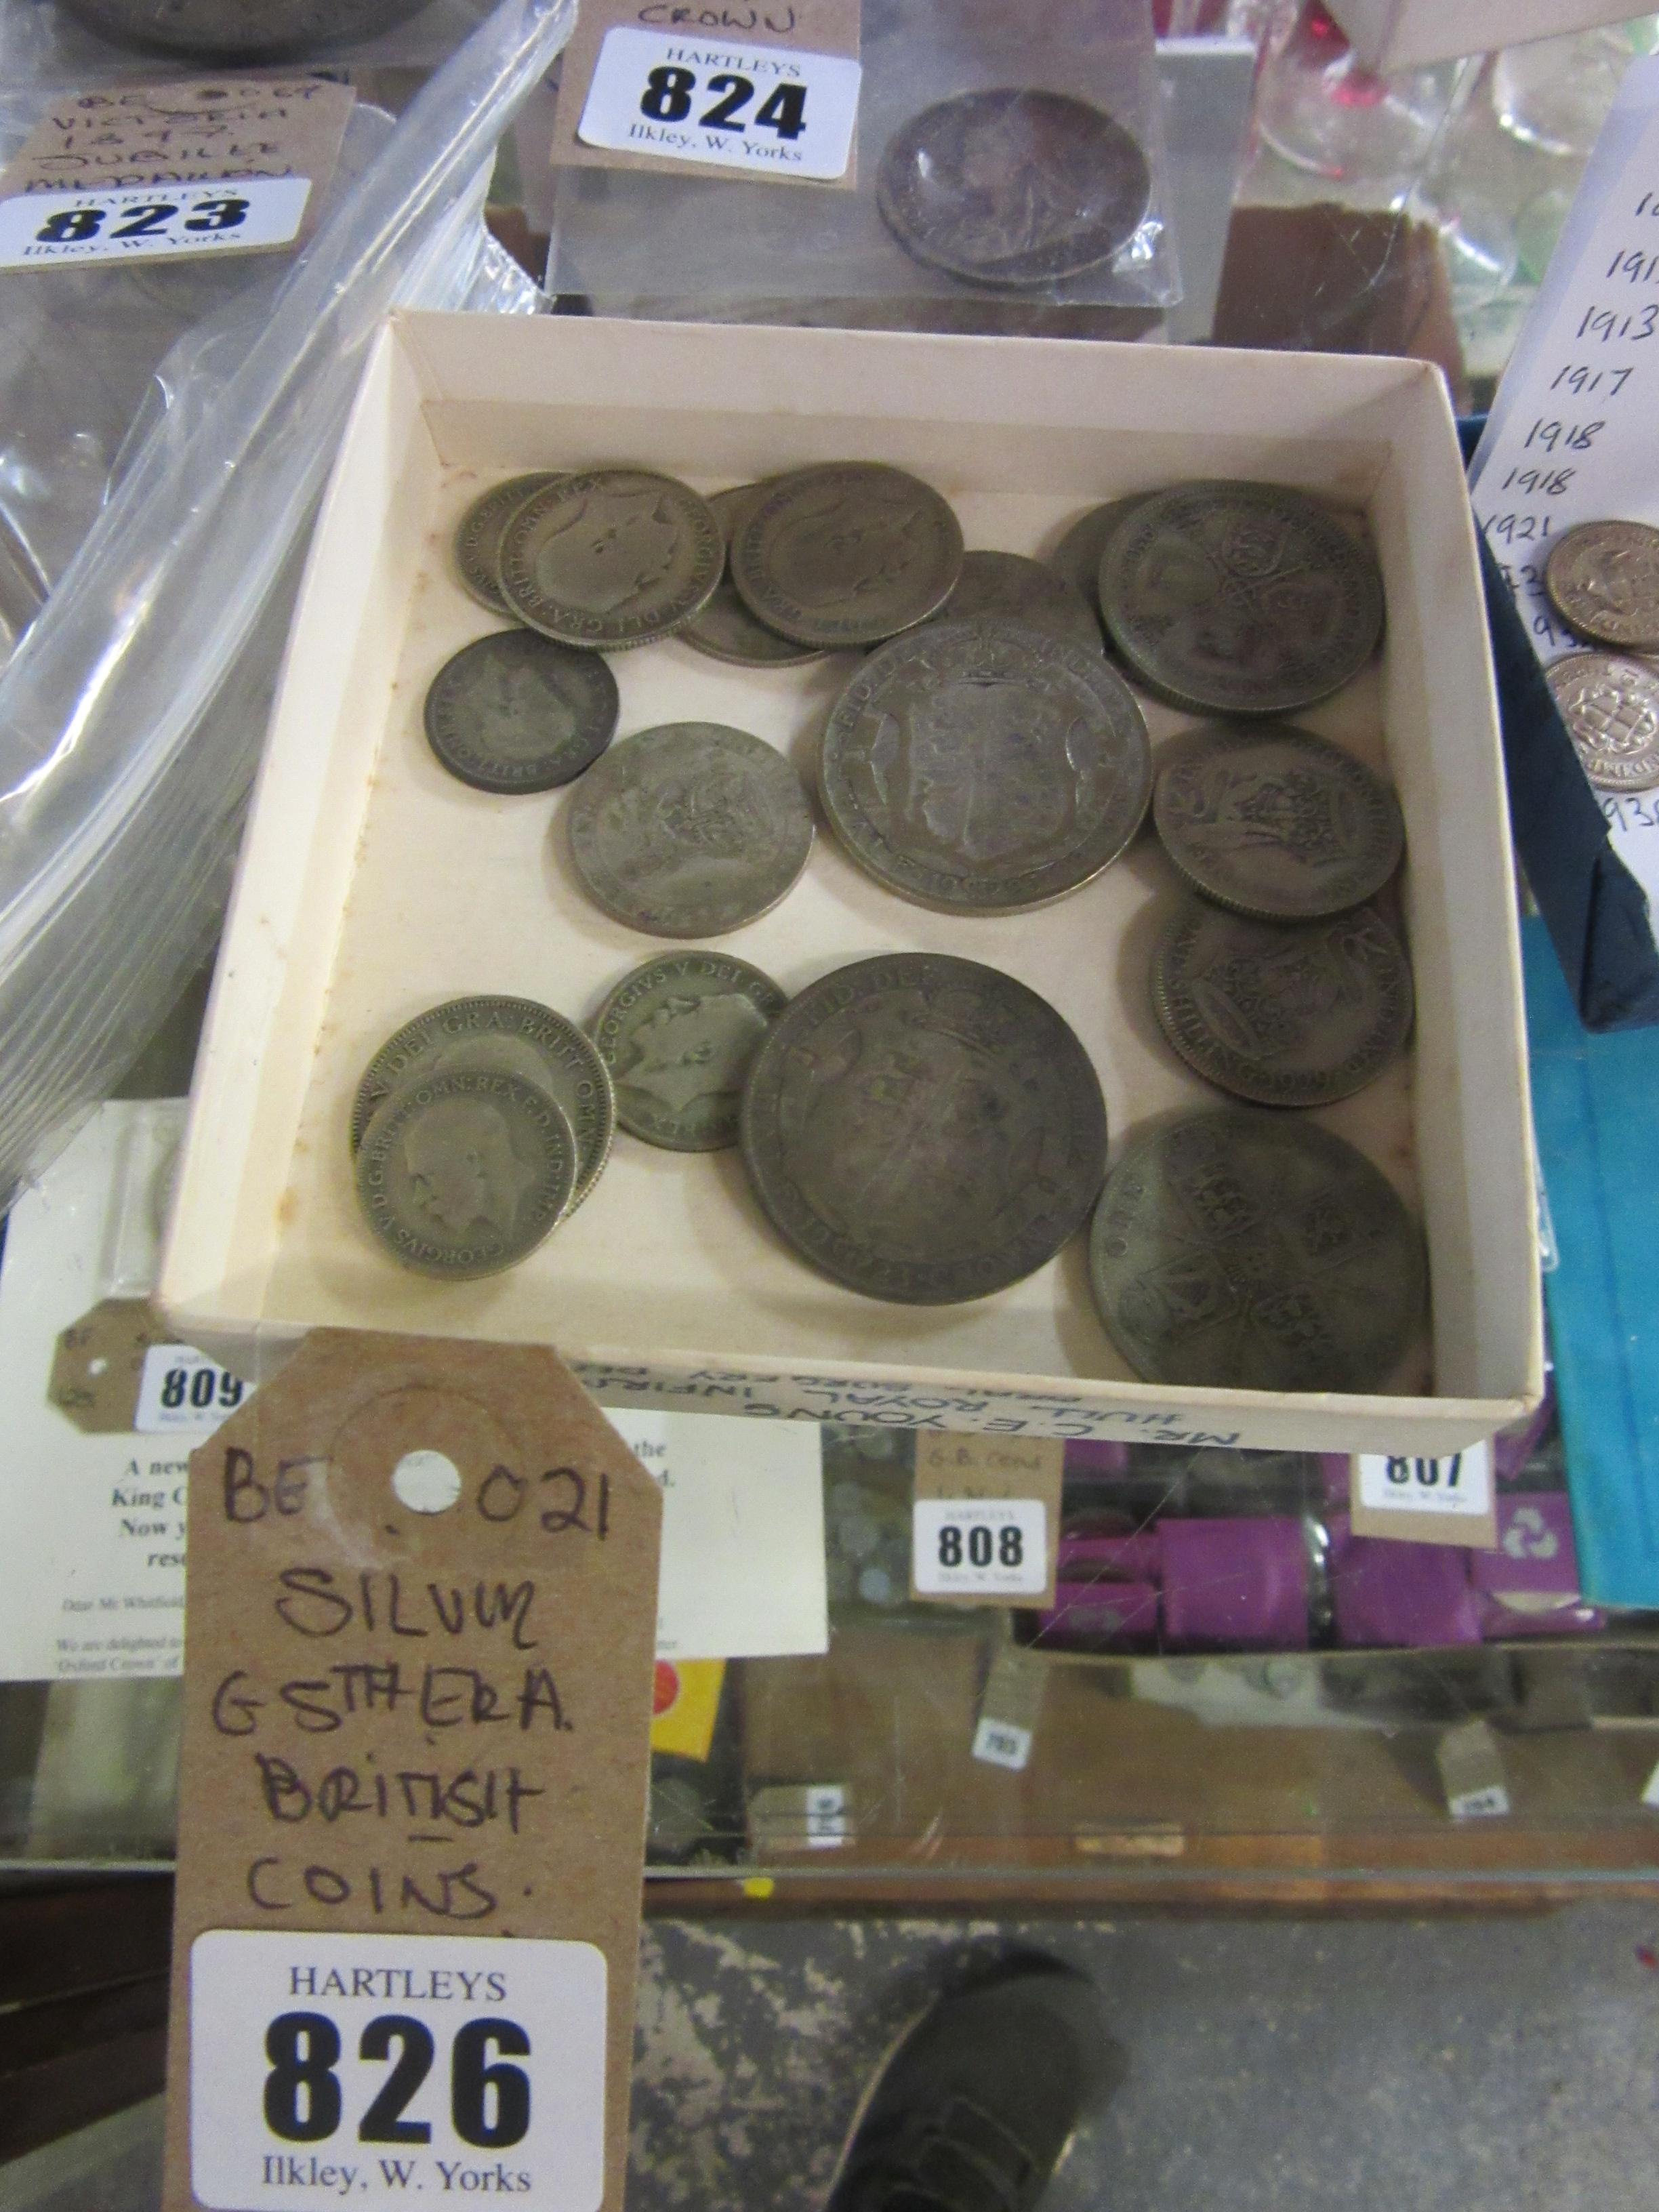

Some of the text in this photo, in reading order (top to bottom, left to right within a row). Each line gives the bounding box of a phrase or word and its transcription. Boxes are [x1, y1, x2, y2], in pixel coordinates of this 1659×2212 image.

[638, 5, 795, 33] CROWN
[666, 48, 801, 77] HARTLEYS
[640, 66, 808, 140] 824
[629, 123, 803, 163] Ilkley, W. Yorks
[74, 189, 239, 207] HARTLEYS
[36, 199, 251, 243] 823
[167, 231, 243, 247] Yorks
[1605, 250, 1659, 283] 191
[1577, 304, 1659, 343] 1913
[1551, 365, 1633, 396] 1917
[1524, 419, 1605, 453] 1918
[1502, 468, 1578, 497] 1918
[1483, 514, 1551, 544] 1921
[162, 1368, 243, 1408] 809
[802, 1389, 989, 1413] ROYAL
[744, 1404, 947, 1431] YOUNG
[634, 1441, 666, 1458] the
[112, 1489, 165, 1509] King
[225, 1448, 332, 1522] BE
[121, 1518, 168, 1536] Now
[938, 1525, 1024, 1568] 808
[289, 1965, 508, 2002] HARTLEYS
[264, 2011, 531, 2149] 826
[262, 2155, 533, 2196] Ilkley, W. Yorks
